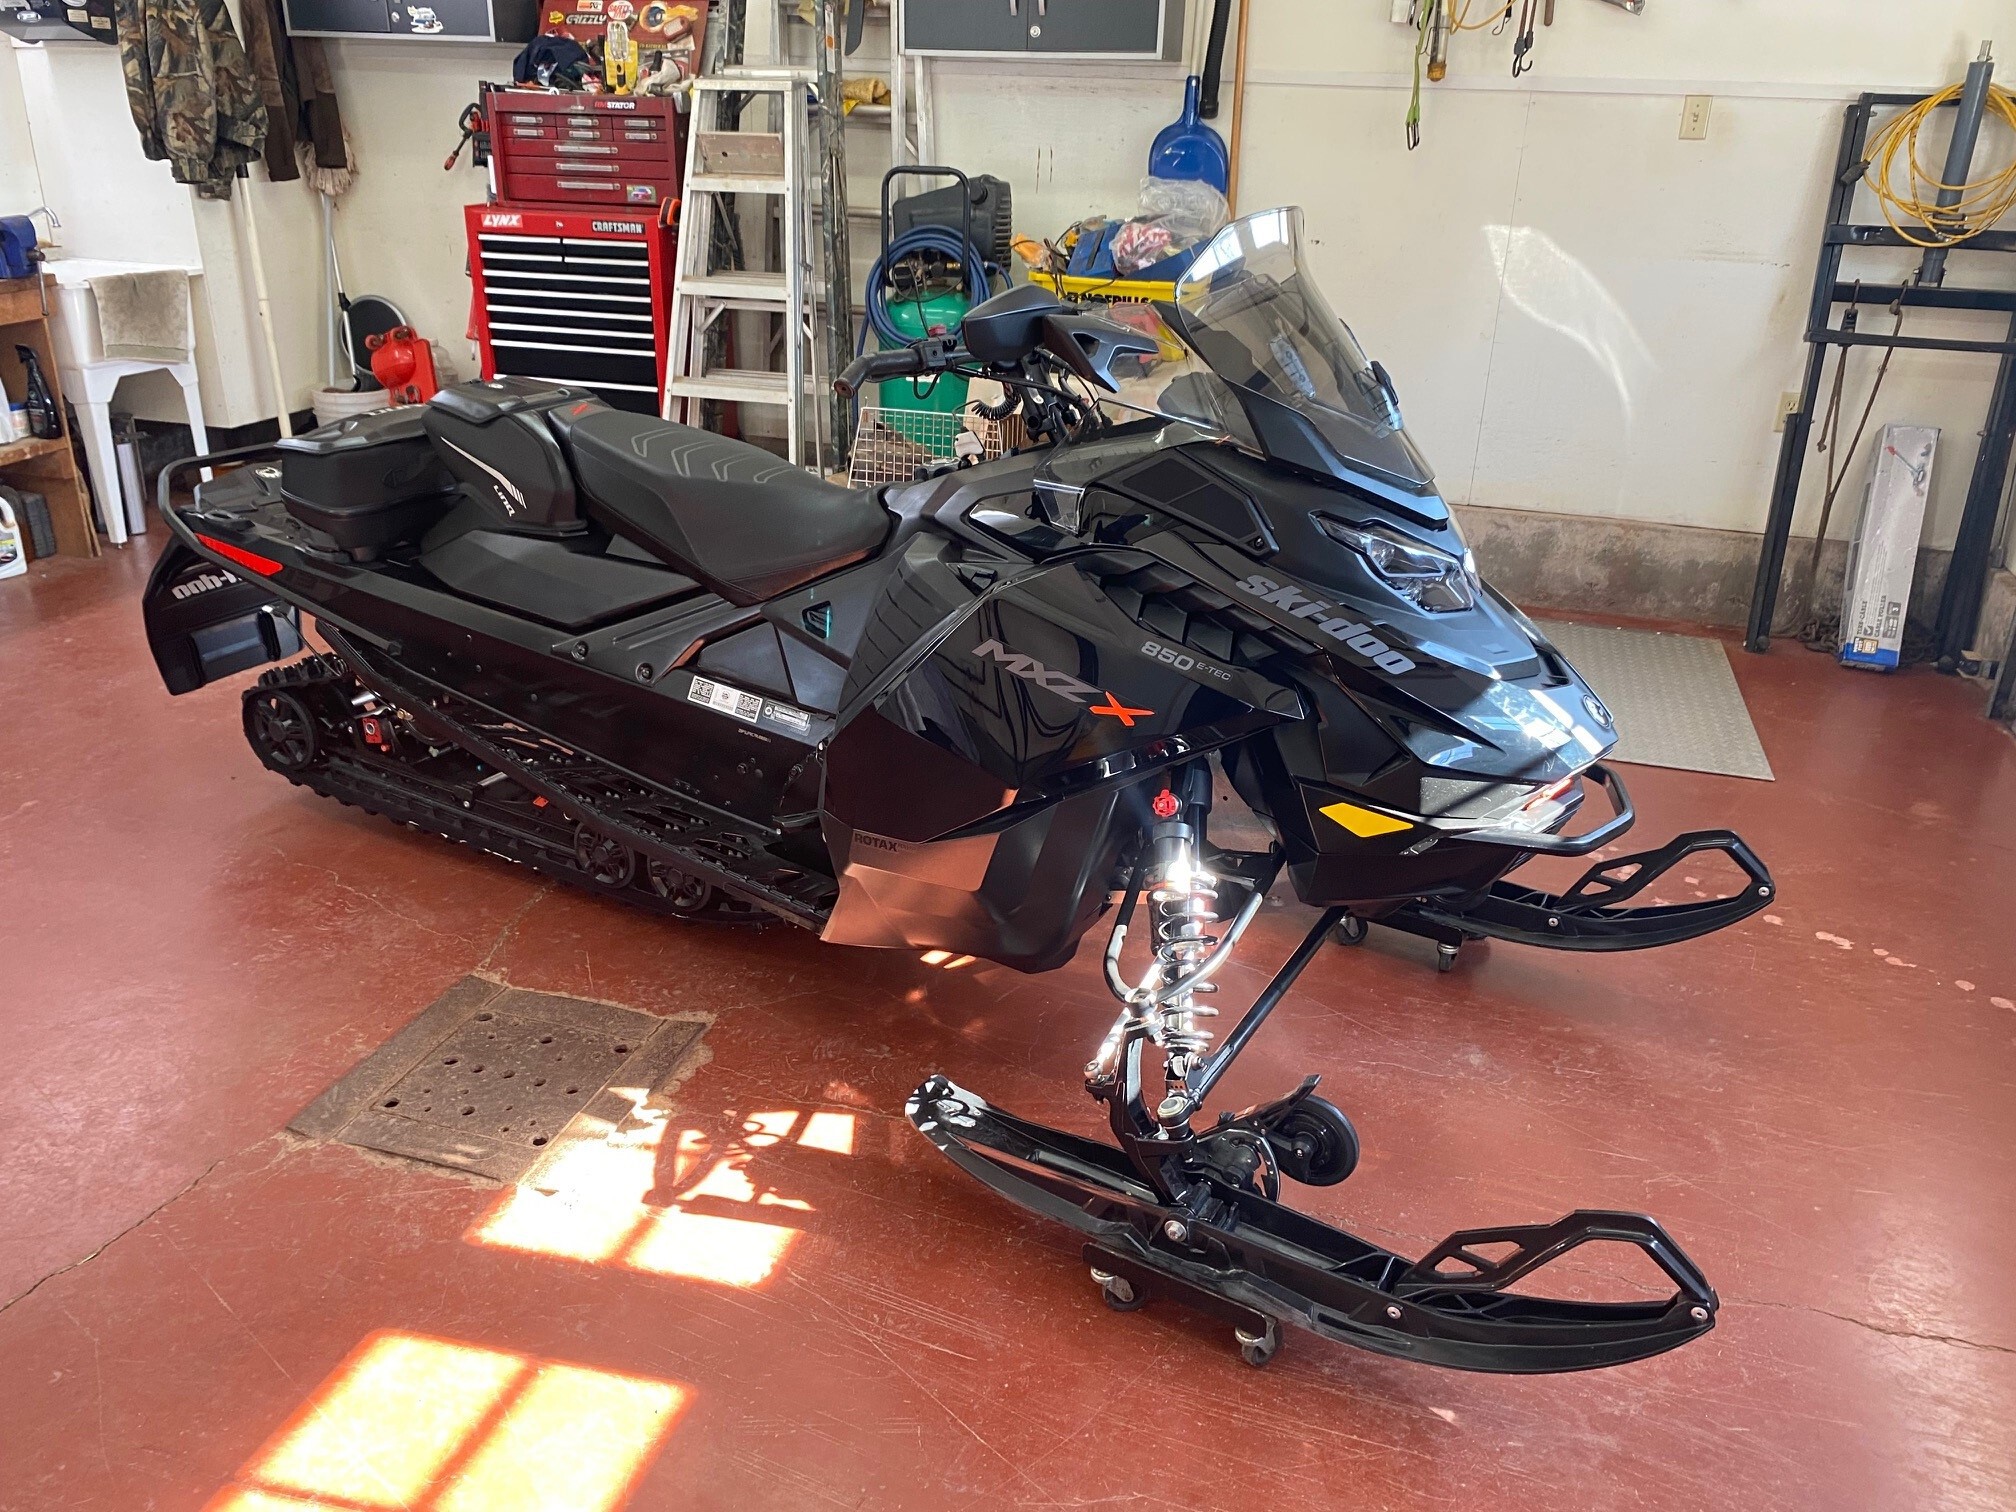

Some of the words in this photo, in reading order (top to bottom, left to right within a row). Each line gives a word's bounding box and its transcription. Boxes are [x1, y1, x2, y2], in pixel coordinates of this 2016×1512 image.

[565, 14, 607, 25] GRIZZLY
[483, 214, 521, 226] LYNX
[592, 221, 643, 233] CRAFTSMAN
[1235, 575, 1416, 675] ski-doo
[1140, 640, 1195, 671] 850
[1196, 662, 1231, 681] E-TEC
[971, 638, 1104, 703] MXZ
[1088, 690, 1155, 727] X
[854, 833, 898, 853] ROTAX
